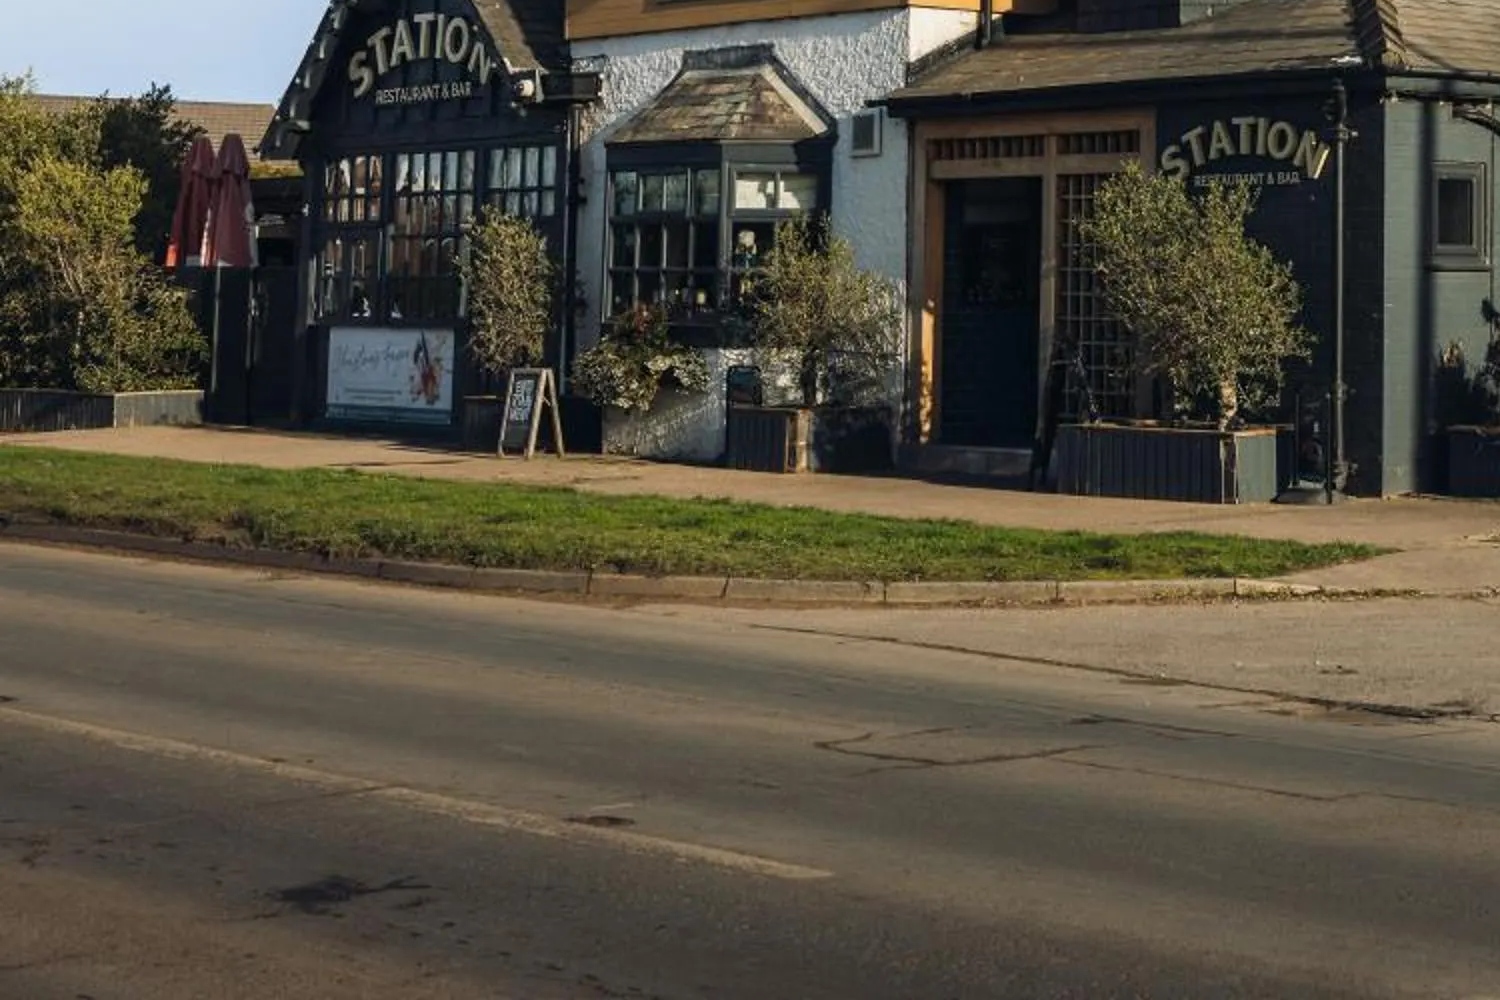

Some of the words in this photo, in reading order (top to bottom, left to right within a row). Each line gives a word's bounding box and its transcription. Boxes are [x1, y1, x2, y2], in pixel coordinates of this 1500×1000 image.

[348, 12, 491, 98] STATION
[375, 84, 441, 105] RESTAURANT
[451, 82, 472, 97] BAR
[1161, 116, 1330, 180] STATION
[1277, 172, 1300, 185] BAR
